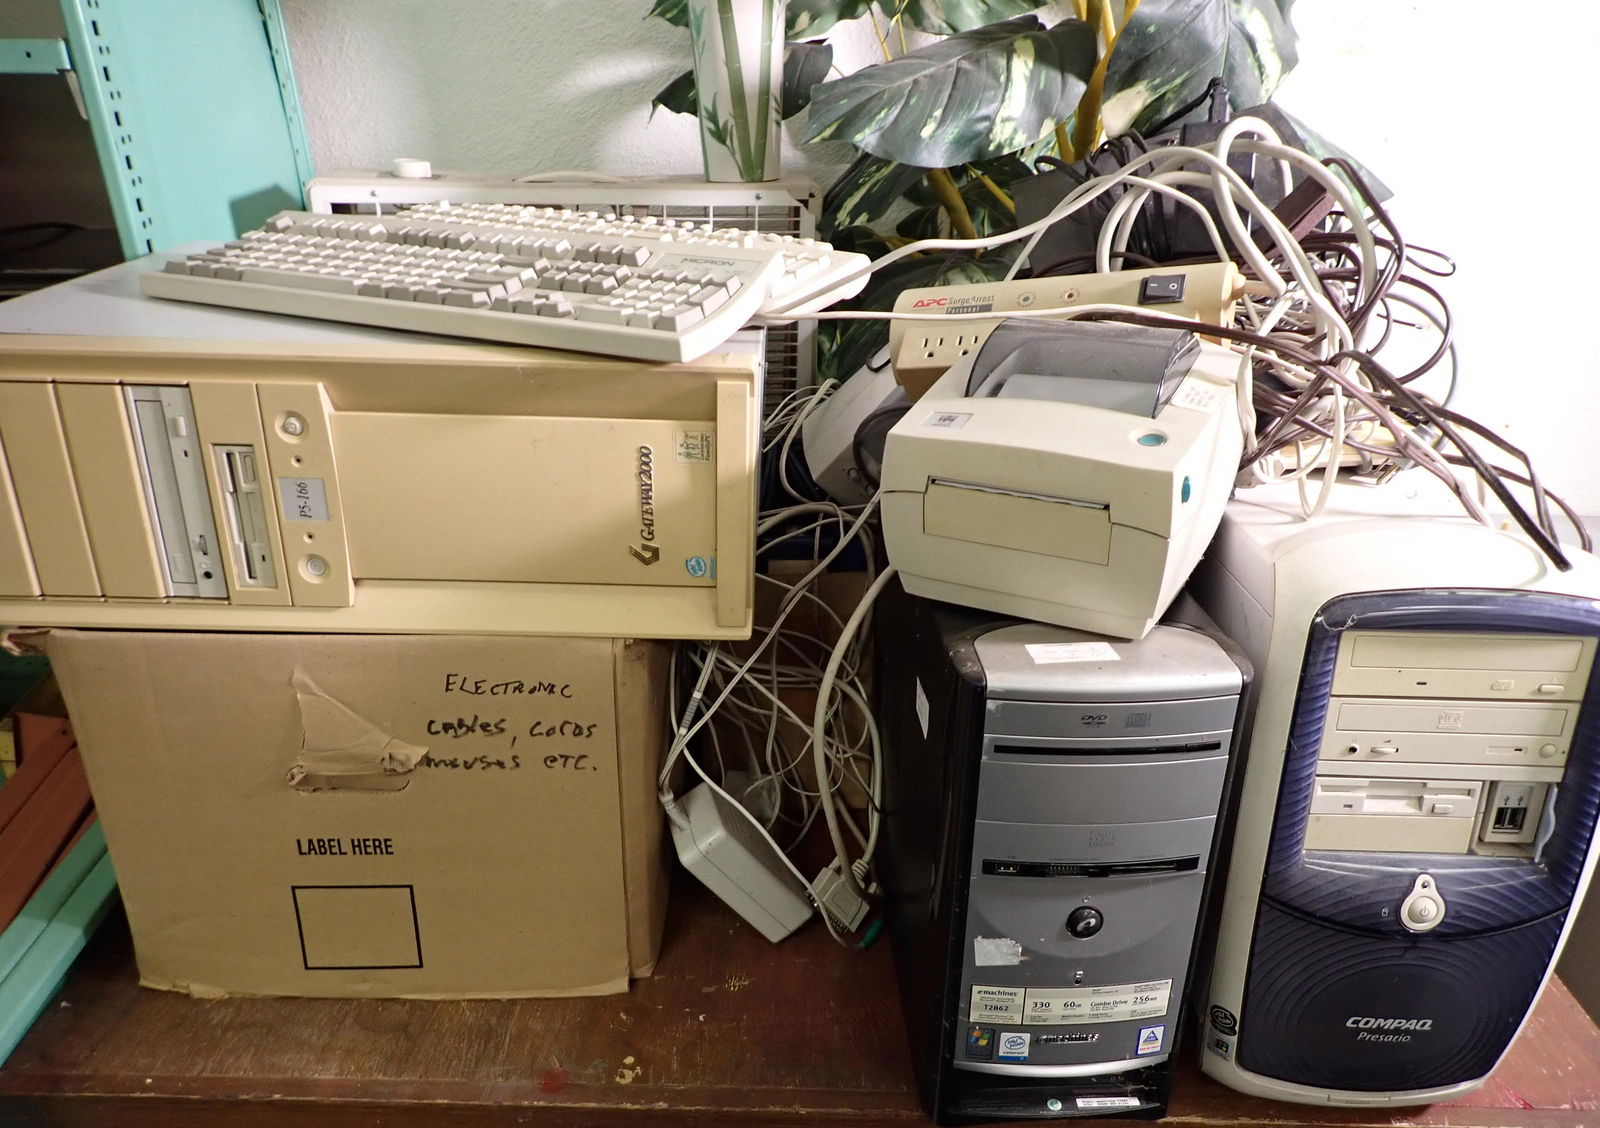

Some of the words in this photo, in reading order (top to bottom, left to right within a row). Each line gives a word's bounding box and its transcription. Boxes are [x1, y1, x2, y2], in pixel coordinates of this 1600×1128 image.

[680, 257, 736, 267] MICRON
[912, 297, 948, 308] APC
[949, 294, 996, 306] SurgeArrest
[947, 305, 981, 315] Personal
[294, 481, 313, 519] P5-166
[296, 837, 348, 856] LABEL
[350, 837, 395, 856] HERE
[1032, 1001, 1051, 1009] 330
[1345, 1016, 1434, 1031] COMPAQ
[1357, 1031, 1412, 1043] Presario
